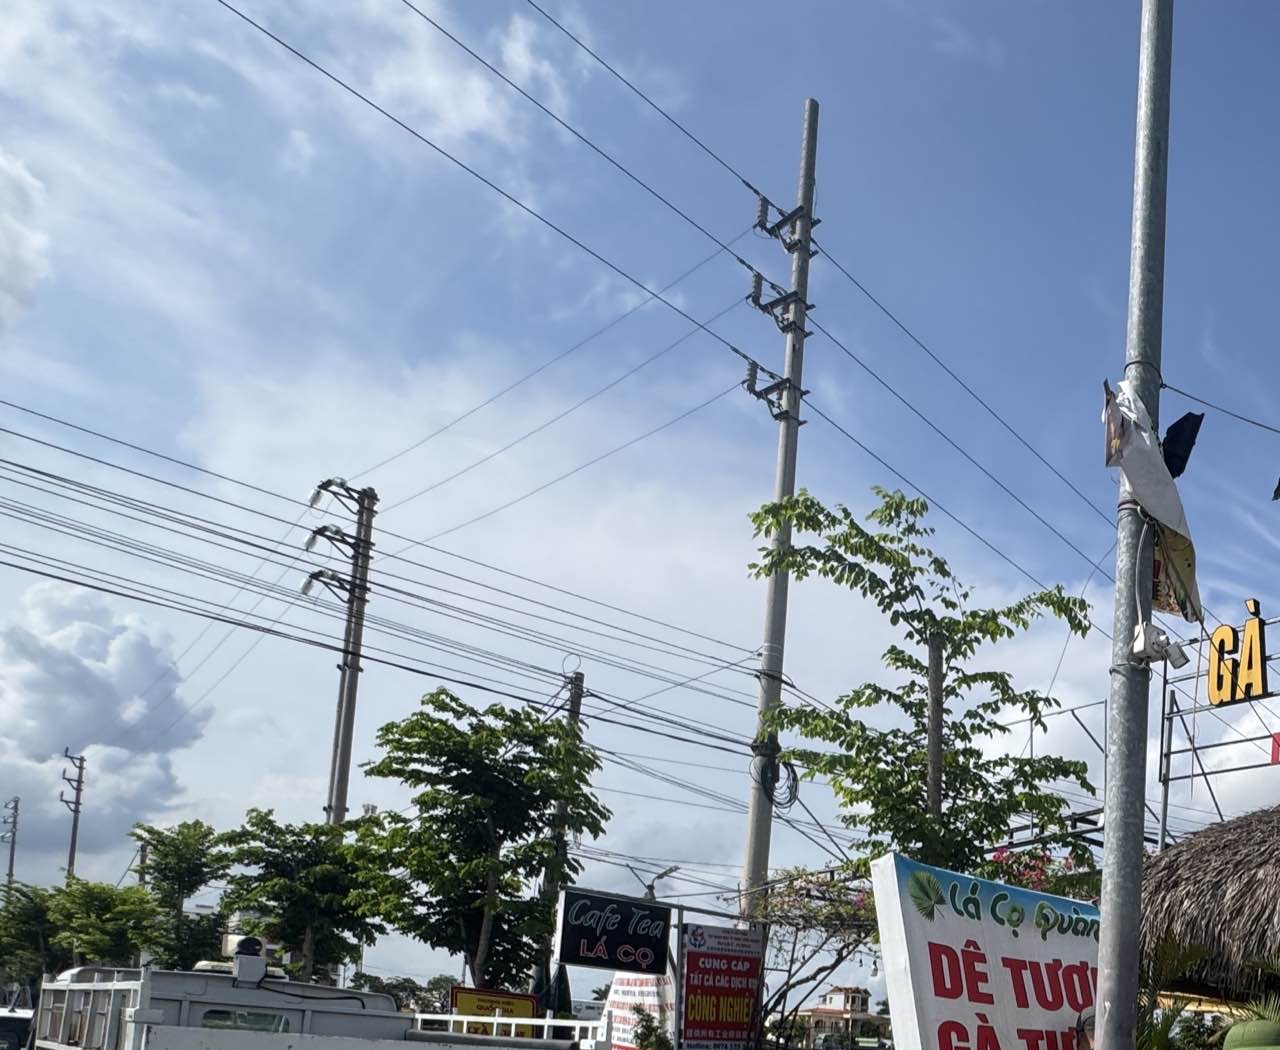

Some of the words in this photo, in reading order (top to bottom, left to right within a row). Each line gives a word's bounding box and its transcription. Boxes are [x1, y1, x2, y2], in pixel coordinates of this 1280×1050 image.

[1208, 598, 1267, 706] GÀ
[568, 899, 621, 936] Cafe
[628, 907, 665, 938] Tea
[950, 881, 981, 921] Lá
[990, 892, 1025, 938] Cọ
[580, 936, 608, 960] LÁ
[617, 945, 654, 969] CỌ
[698, 957, 728, 970] CUNG
[928, 939, 994, 1005] DÊ
